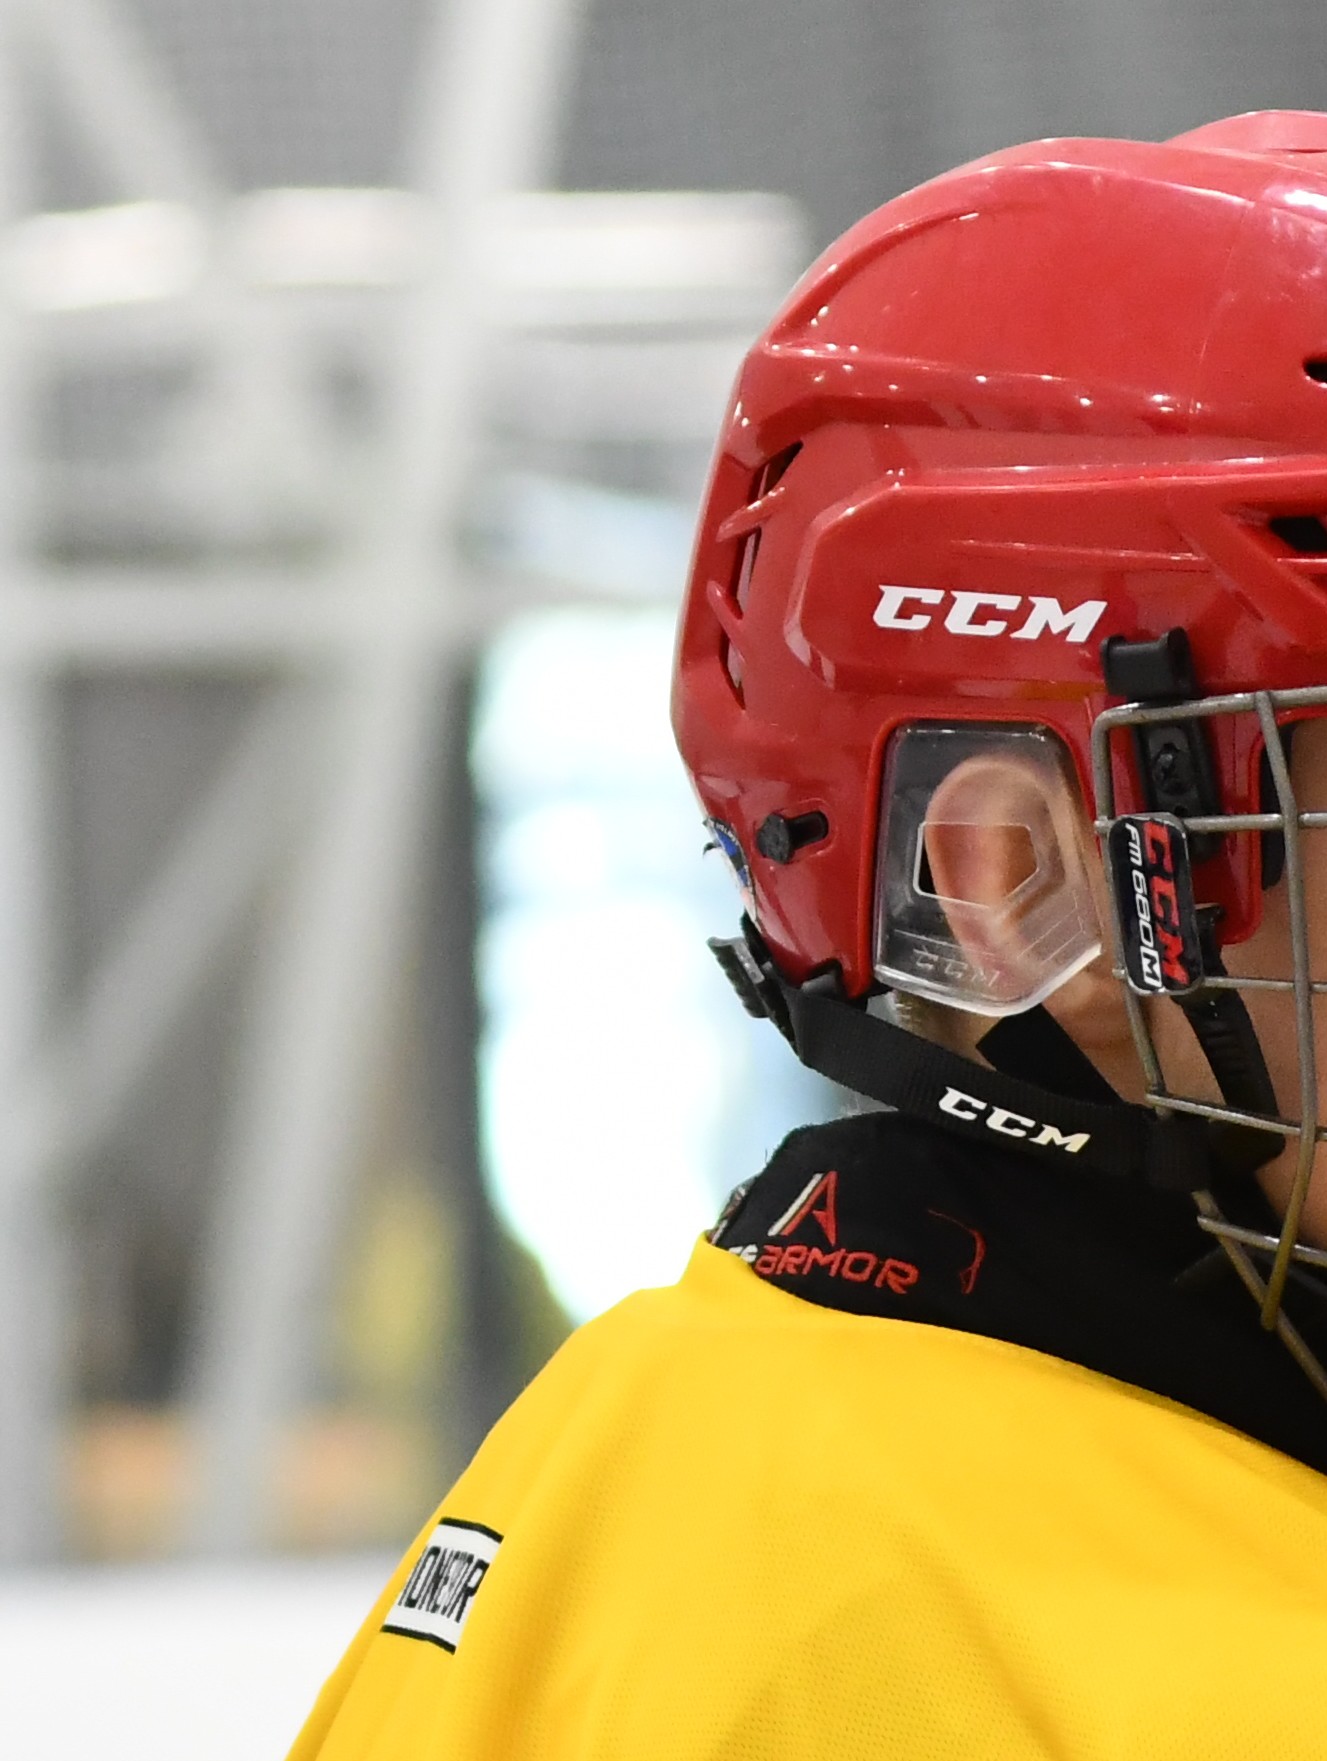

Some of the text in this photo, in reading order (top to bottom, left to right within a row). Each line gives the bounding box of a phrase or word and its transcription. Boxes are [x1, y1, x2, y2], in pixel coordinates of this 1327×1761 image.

[873, 585, 1108, 643] CCM
[1143, 821, 1190, 986] CCM
[938, 1086, 1091, 1153] CCM
